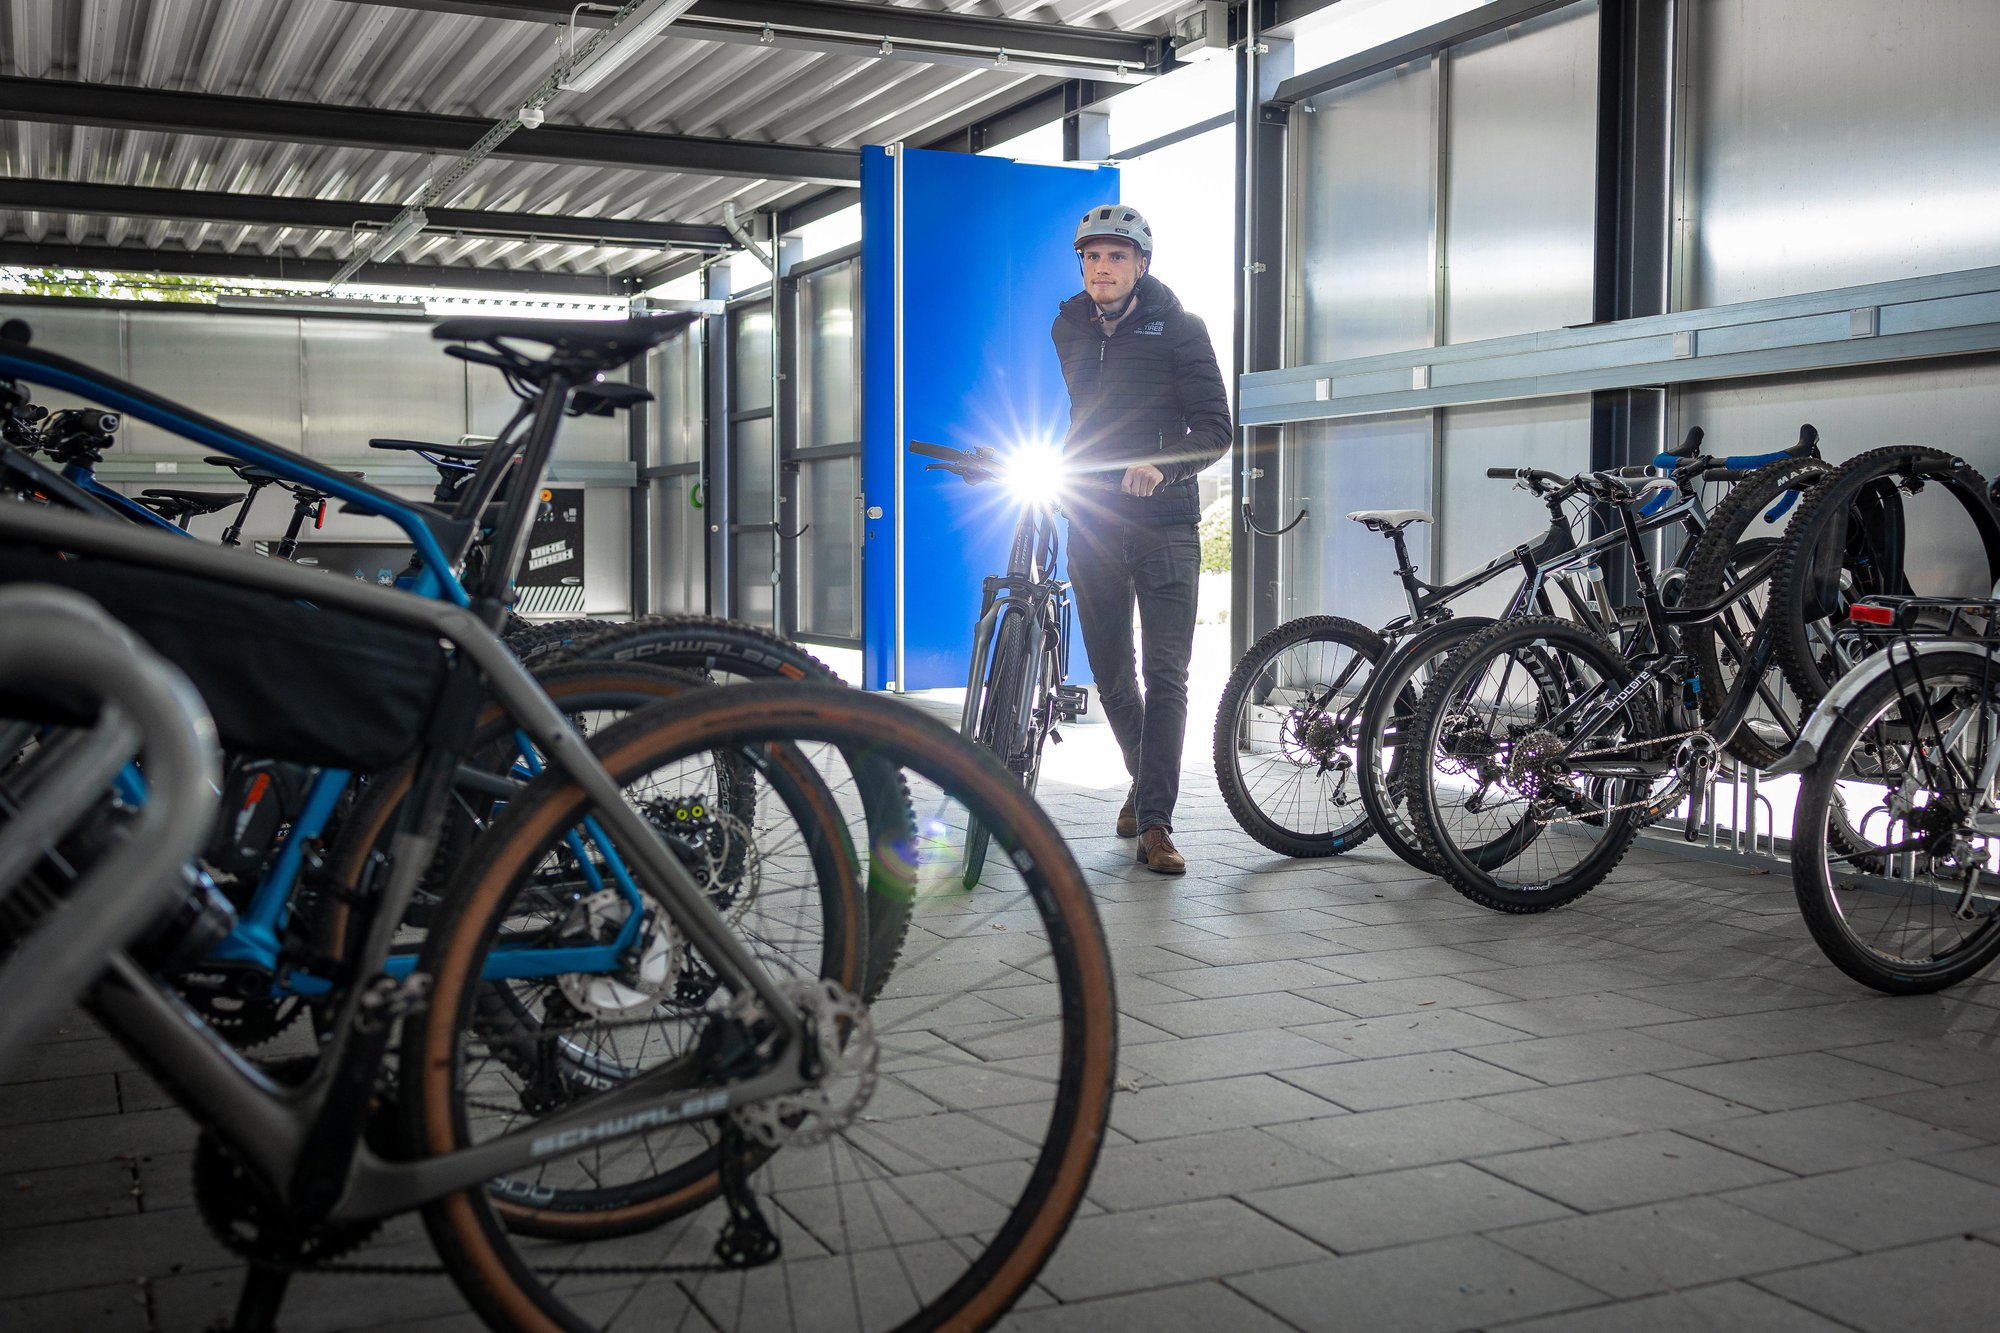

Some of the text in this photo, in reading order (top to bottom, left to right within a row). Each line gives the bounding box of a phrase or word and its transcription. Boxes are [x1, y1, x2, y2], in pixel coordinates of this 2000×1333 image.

[528, 548, 574, 571] WASH
[613, 640, 783, 669] SCHWALBE
[530, 1091, 731, 1156] SCHWALBE
